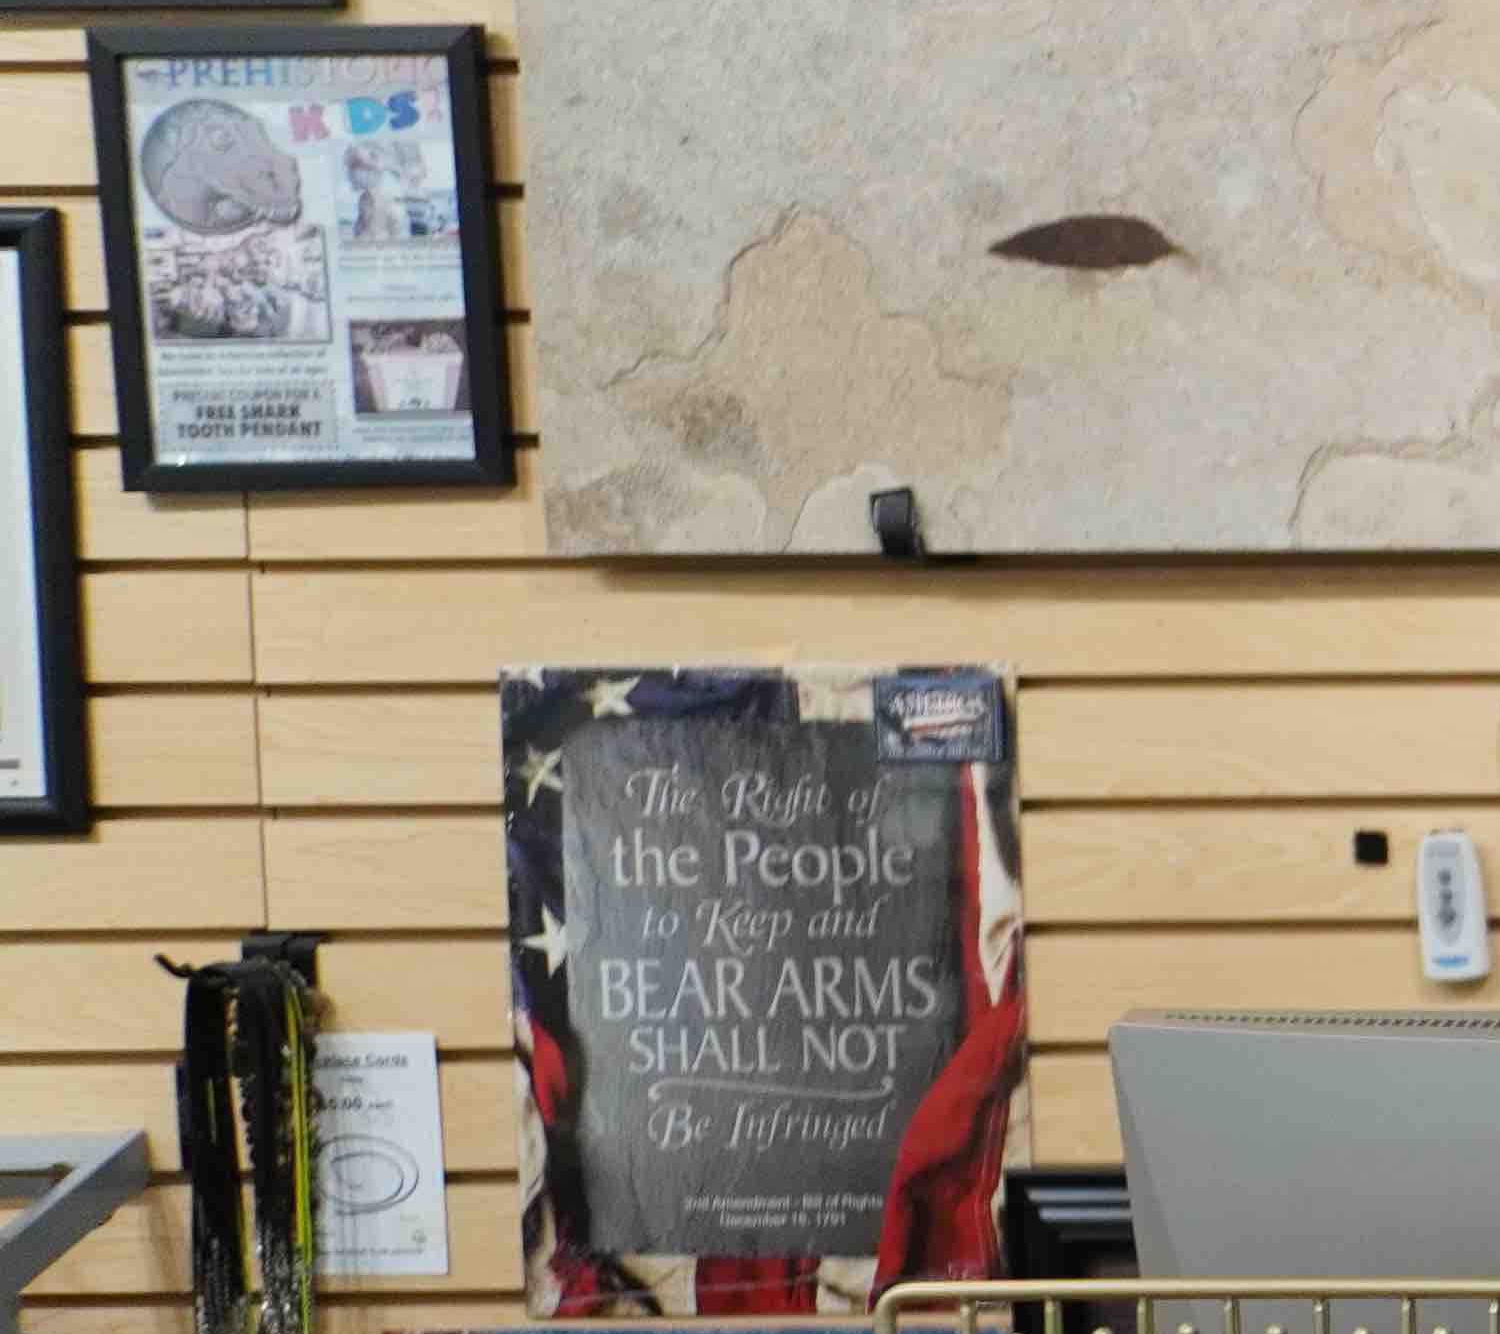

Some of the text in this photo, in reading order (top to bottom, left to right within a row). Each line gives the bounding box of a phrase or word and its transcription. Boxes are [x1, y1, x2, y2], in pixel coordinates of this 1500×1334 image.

[177, 420, 323, 439] TOOTH PENDANT
[239, 403, 302, 420] SHARK
[624, 761, 894, 828] The Right of
[609, 823, 915, 907] the People
[641, 891, 894, 956] to Keep and
[600, 955, 938, 1021] BEAR ARMS
[629, 1022, 909, 1075] SHALL NOT
[648, 1098, 897, 1154] Be Infringed
